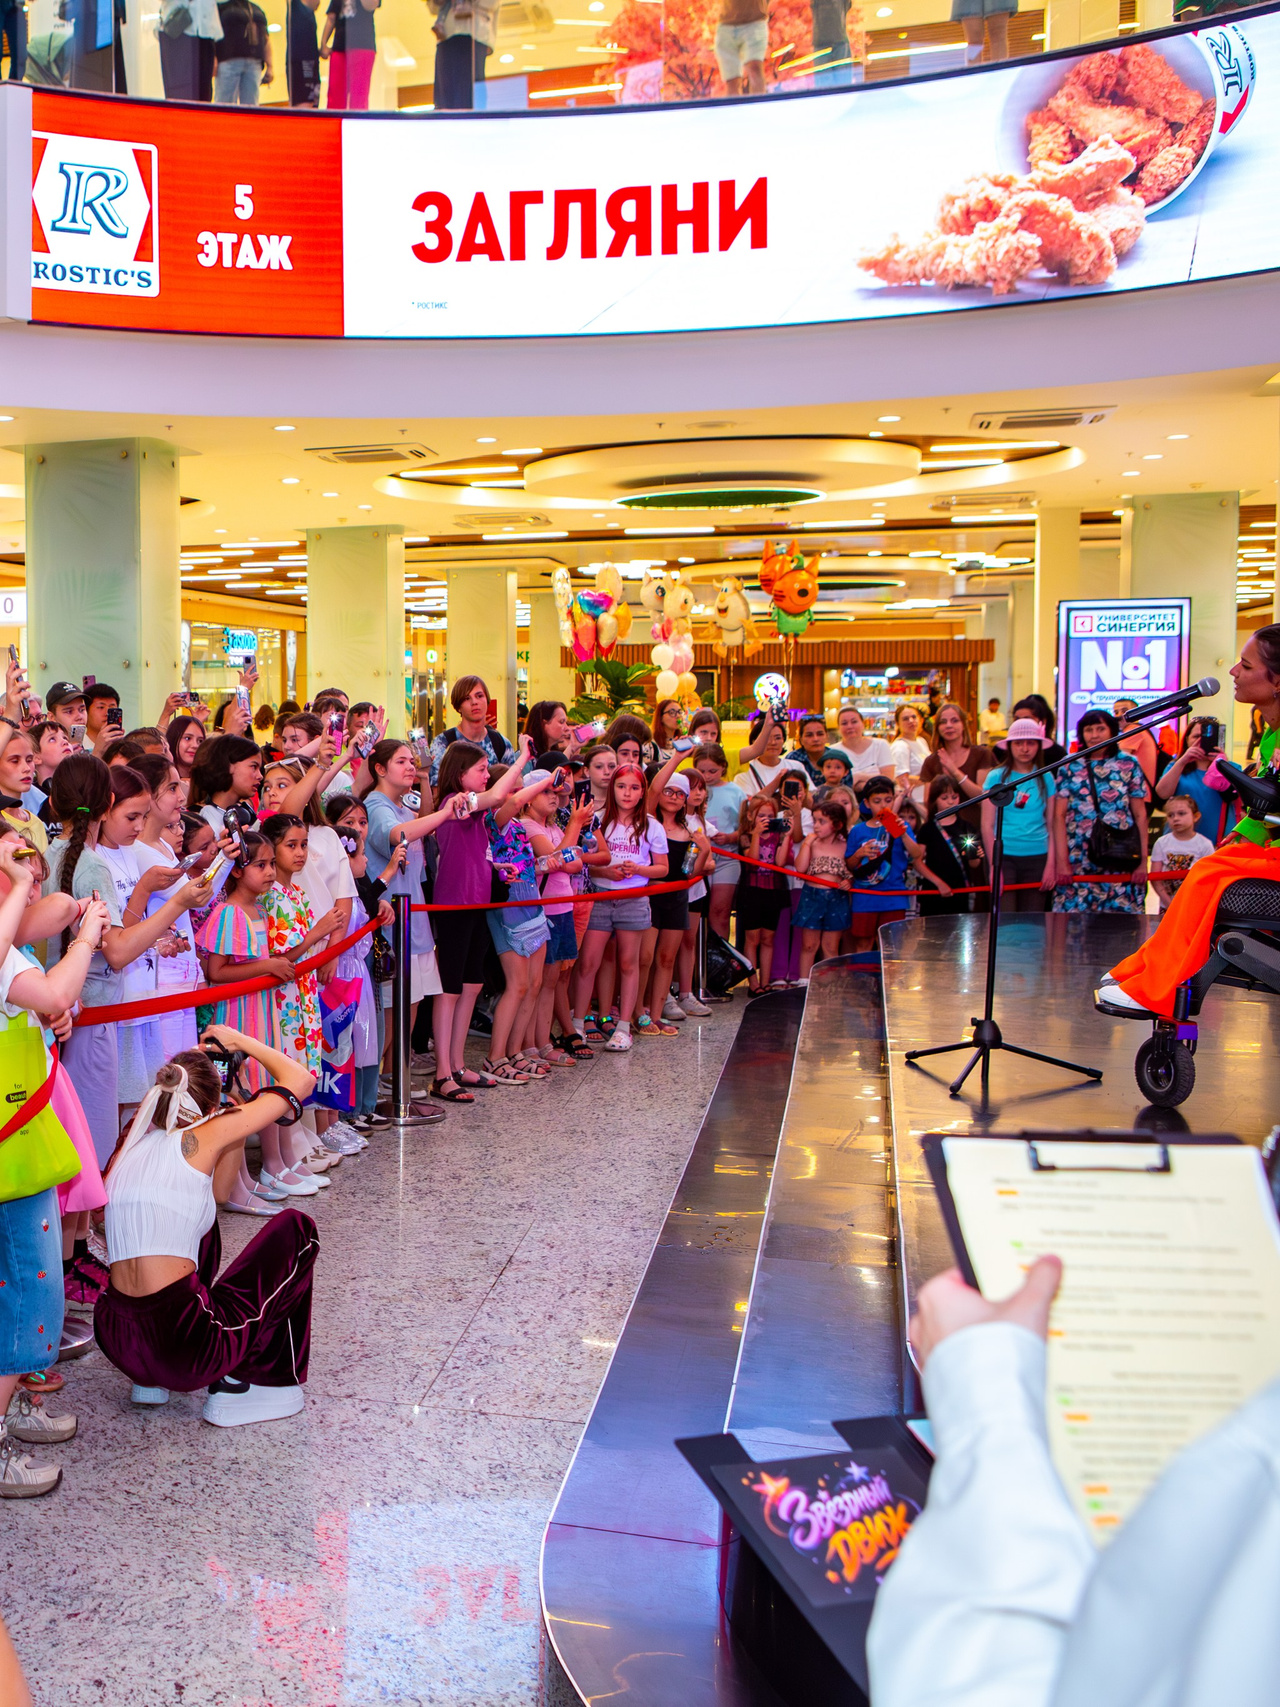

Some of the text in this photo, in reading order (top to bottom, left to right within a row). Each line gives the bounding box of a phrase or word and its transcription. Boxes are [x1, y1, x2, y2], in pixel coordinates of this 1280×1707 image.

[51, 161, 129, 239] R
[233, 184, 255, 220] 5
[411, 176, 768, 264] ЗАГЛЯНИ
[196, 231, 294, 271] ЭТАЖ
[32, 260, 153, 289] ROSTIC'S
[3, 597, 14, 614] 0
[1096, 613, 1176, 622] УНИВЕРСИТЕТ
[1096, 621, 1176, 633] СИНЕРГИЯ
[1080, 639, 1167, 691] №1
[19, 1128, 30, 1136] app
